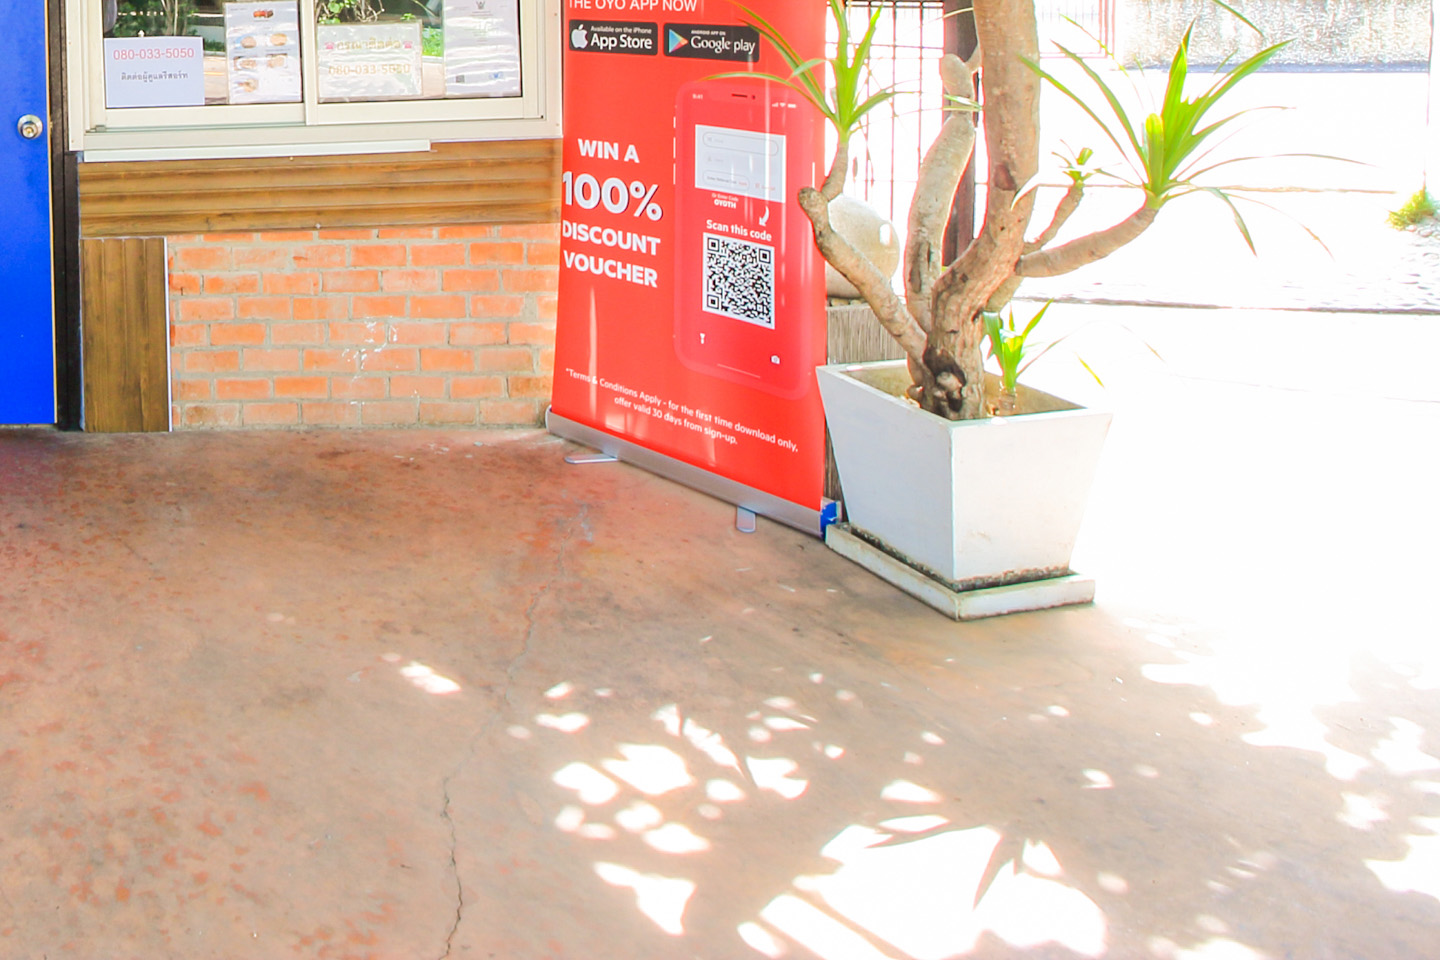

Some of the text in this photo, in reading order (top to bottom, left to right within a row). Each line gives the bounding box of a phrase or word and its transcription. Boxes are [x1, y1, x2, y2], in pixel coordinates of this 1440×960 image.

[590, 25, 614, 33] Available
[113, 48, 194, 60] 080-033-5050
[590, 33, 653, 51] App Store
[690, 36, 756, 55] Google play
[577, 138, 640, 164] WIN A
[562, 171, 663, 222] 100%
[714, 198, 737, 210] OYOTH
[562, 219, 661, 257] DISCOUNT
[706, 220, 772, 242] Scan this code
[563, 249, 659, 289] VOUCHER
[591, 376, 598, 385] &
[599, 378, 638, 399] Conditions
[639, 391, 662, 407] Apply
[668, 399, 680, 411] for
[680, 405, 694, 417] the
[695, 408, 712, 422] first
[714, 416, 733, 430] time
[734, 422, 776, 444] download
[614, 396, 738, 445] offer valid 30 days from sign-up.
